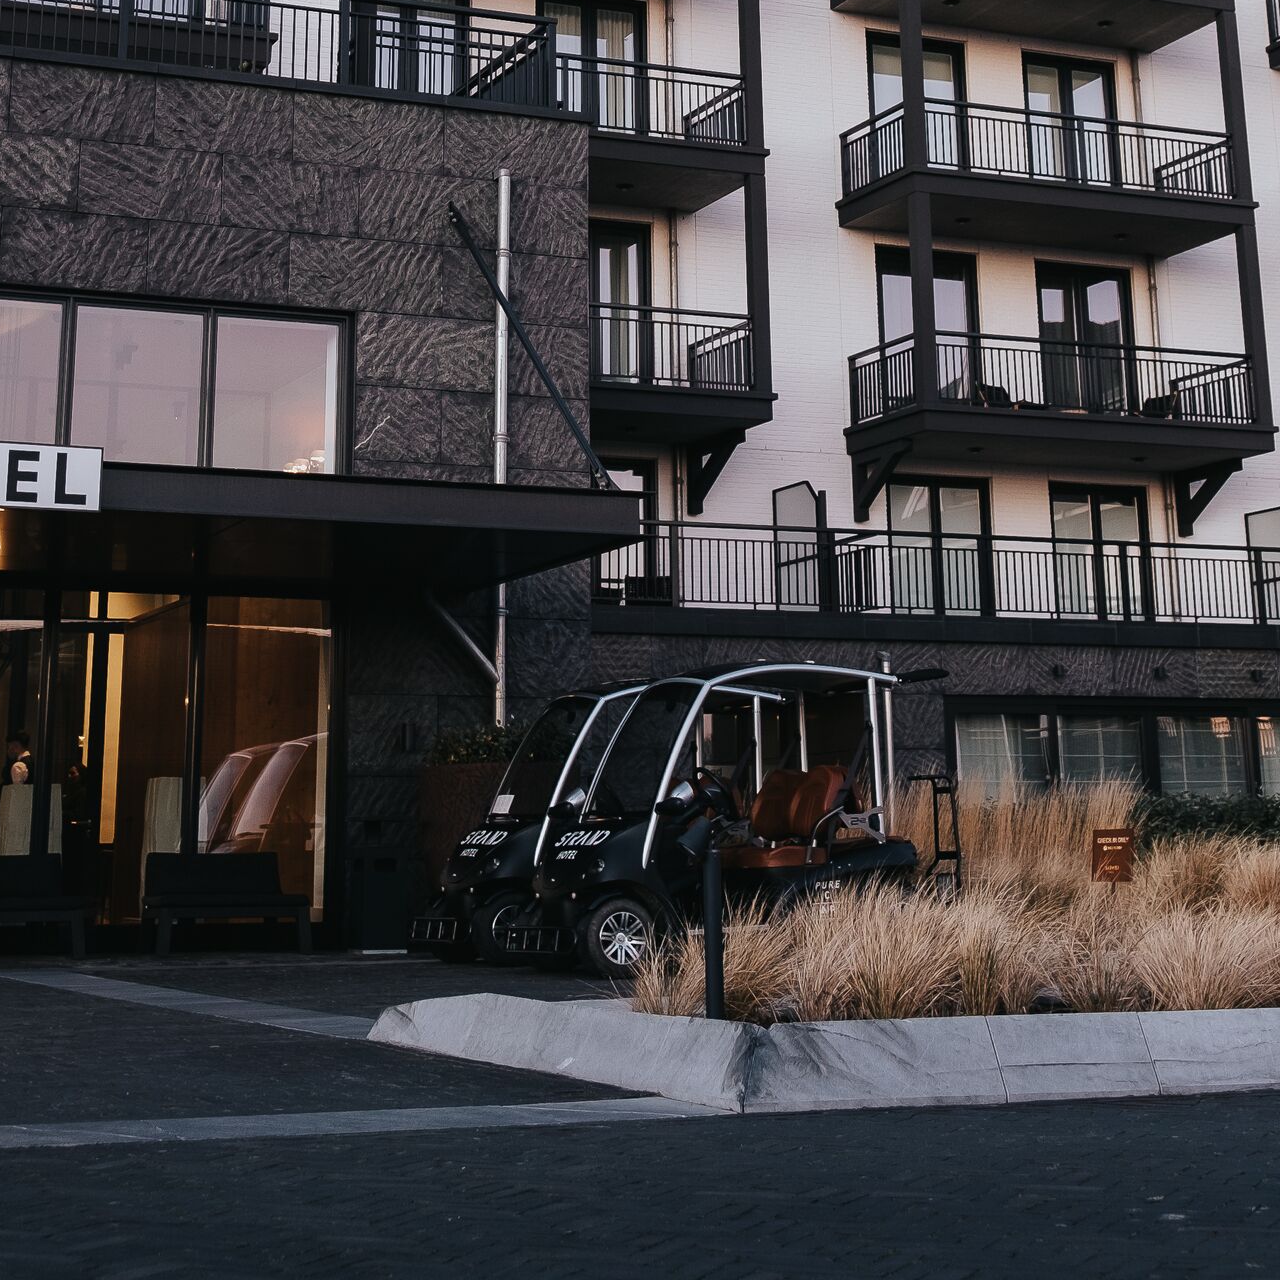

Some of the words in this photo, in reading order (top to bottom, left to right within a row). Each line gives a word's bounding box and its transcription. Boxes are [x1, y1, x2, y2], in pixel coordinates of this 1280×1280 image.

[460, 830, 508, 846] STRAND
[554, 830, 611, 847] STRAND
[460, 849, 479, 857] HOTEL
[555, 850, 578, 860] HOTEL
[815, 879, 841, 891] PURE
